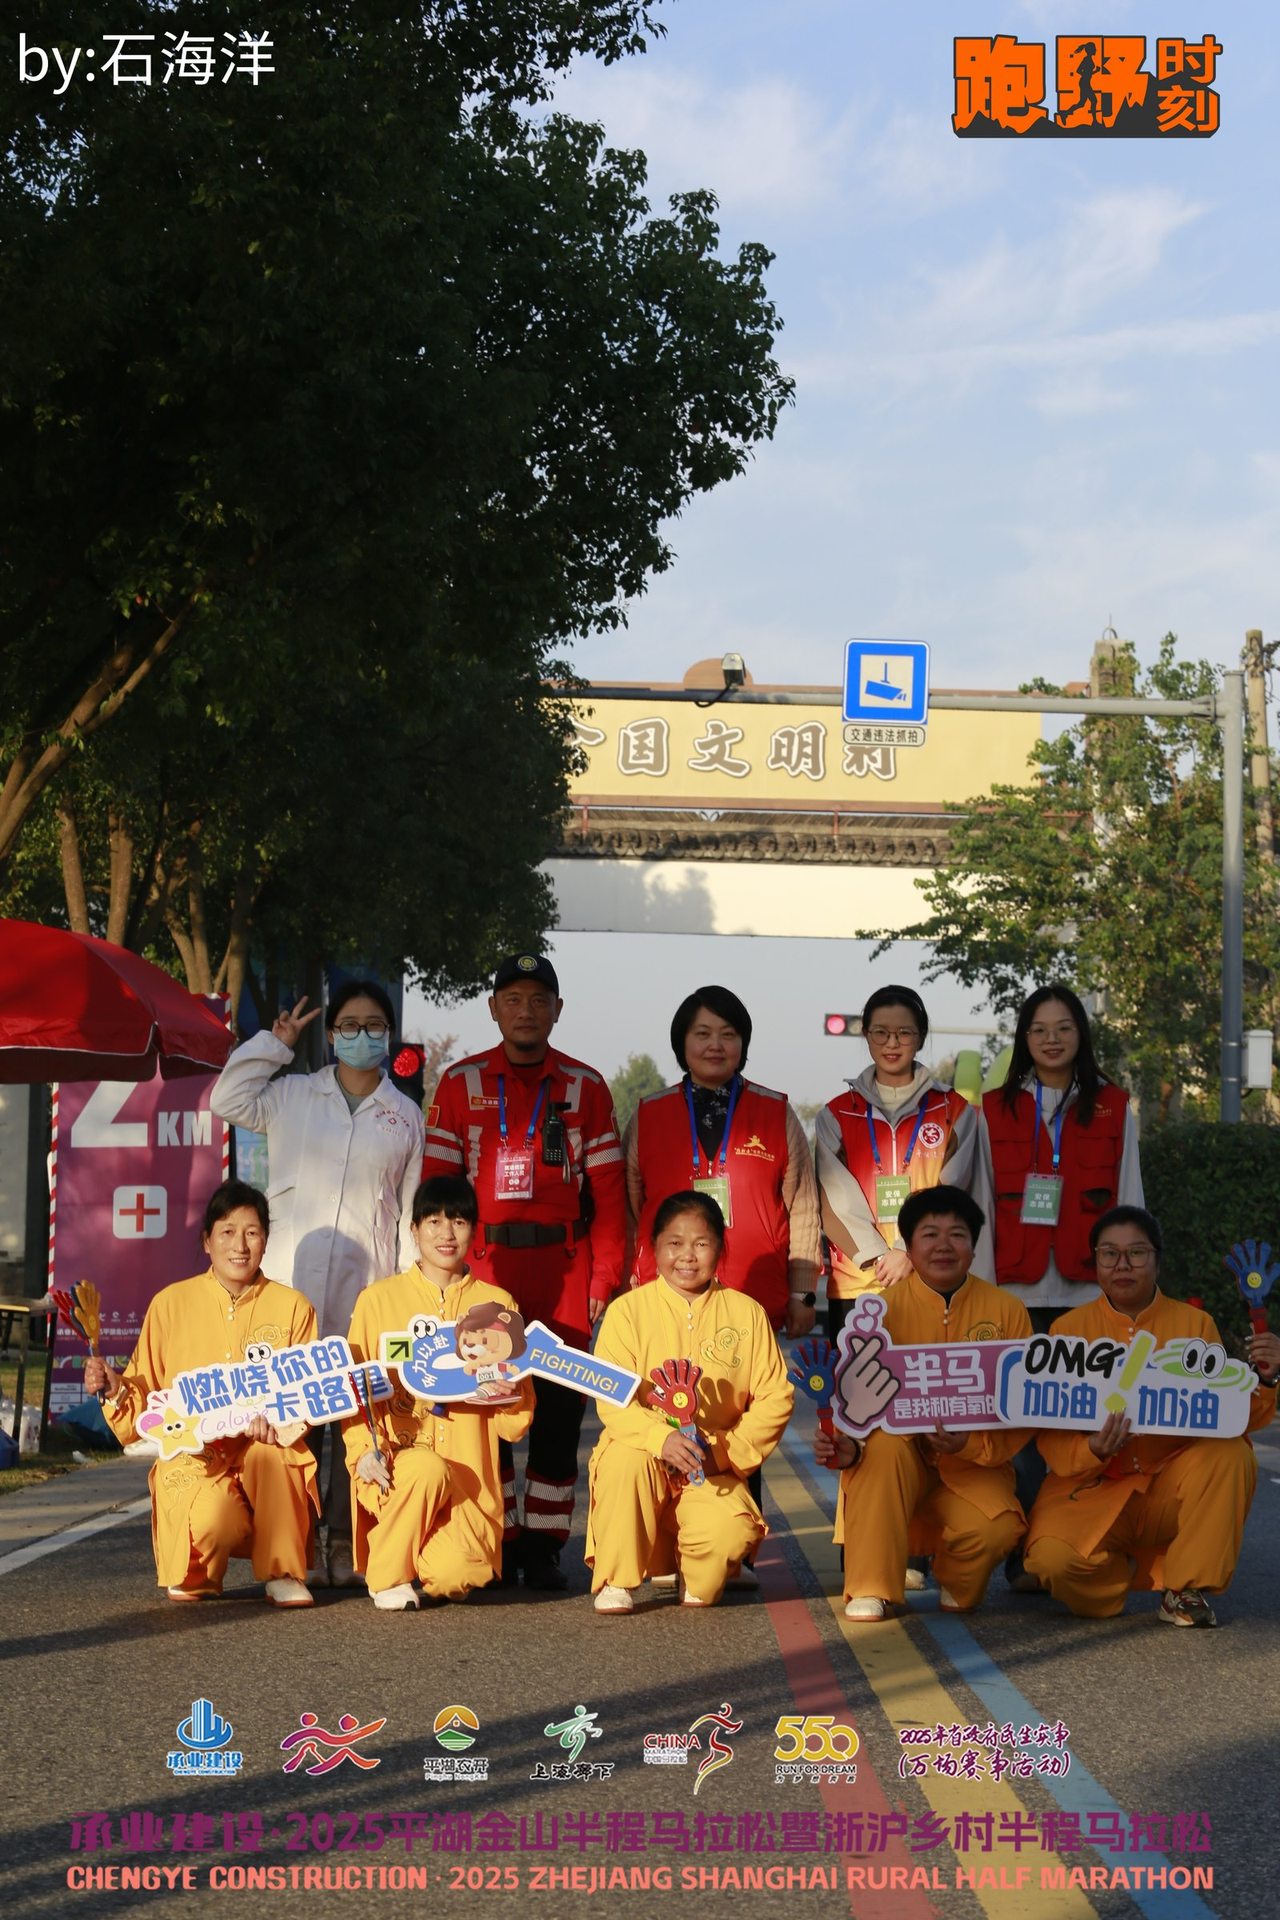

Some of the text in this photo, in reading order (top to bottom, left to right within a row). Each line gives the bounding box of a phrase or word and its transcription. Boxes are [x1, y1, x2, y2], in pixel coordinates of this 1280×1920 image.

[571, 717, 897, 781] 国文明村
[851, 727, 919, 744] 交通违法抓拍
[158, 1111, 212, 1147] KM
[178, 1340, 350, 1416] 燃烧你的
[411, 1334, 450, 1388] 全力以赴
[529, 1349, 620, 1394] FIGHTING!
[904, 1349, 986, 1395] 半马
[265, 1363, 390, 1422] 卡路里
[1023, 1379, 1220, 1430] 加油 加油
